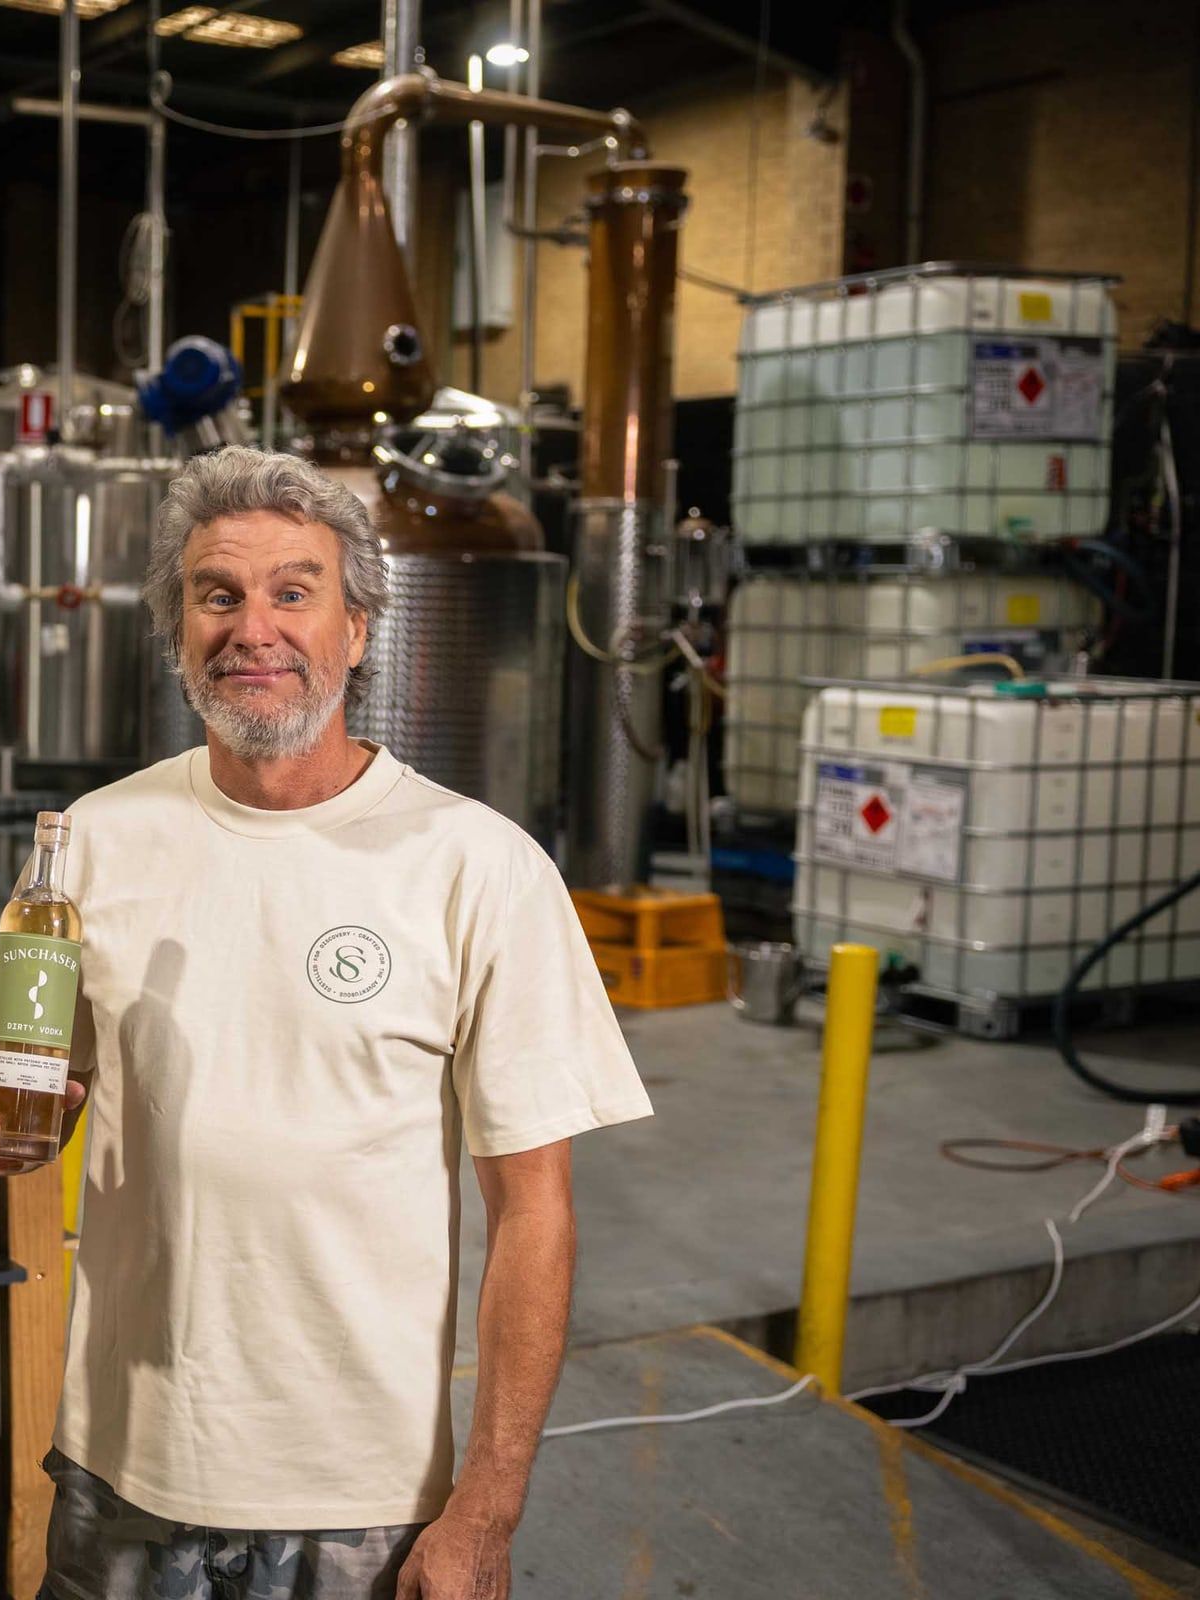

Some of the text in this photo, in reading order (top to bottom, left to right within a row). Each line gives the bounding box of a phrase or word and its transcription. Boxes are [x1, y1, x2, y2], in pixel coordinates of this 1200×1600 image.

[320, 931, 350, 948] DISCOVERY
[358, 932, 380, 951] CRAFTED
[3, 948, 77, 972] SUNCHASER
[7, 1022, 63, 1036] DIRTY VODKA
